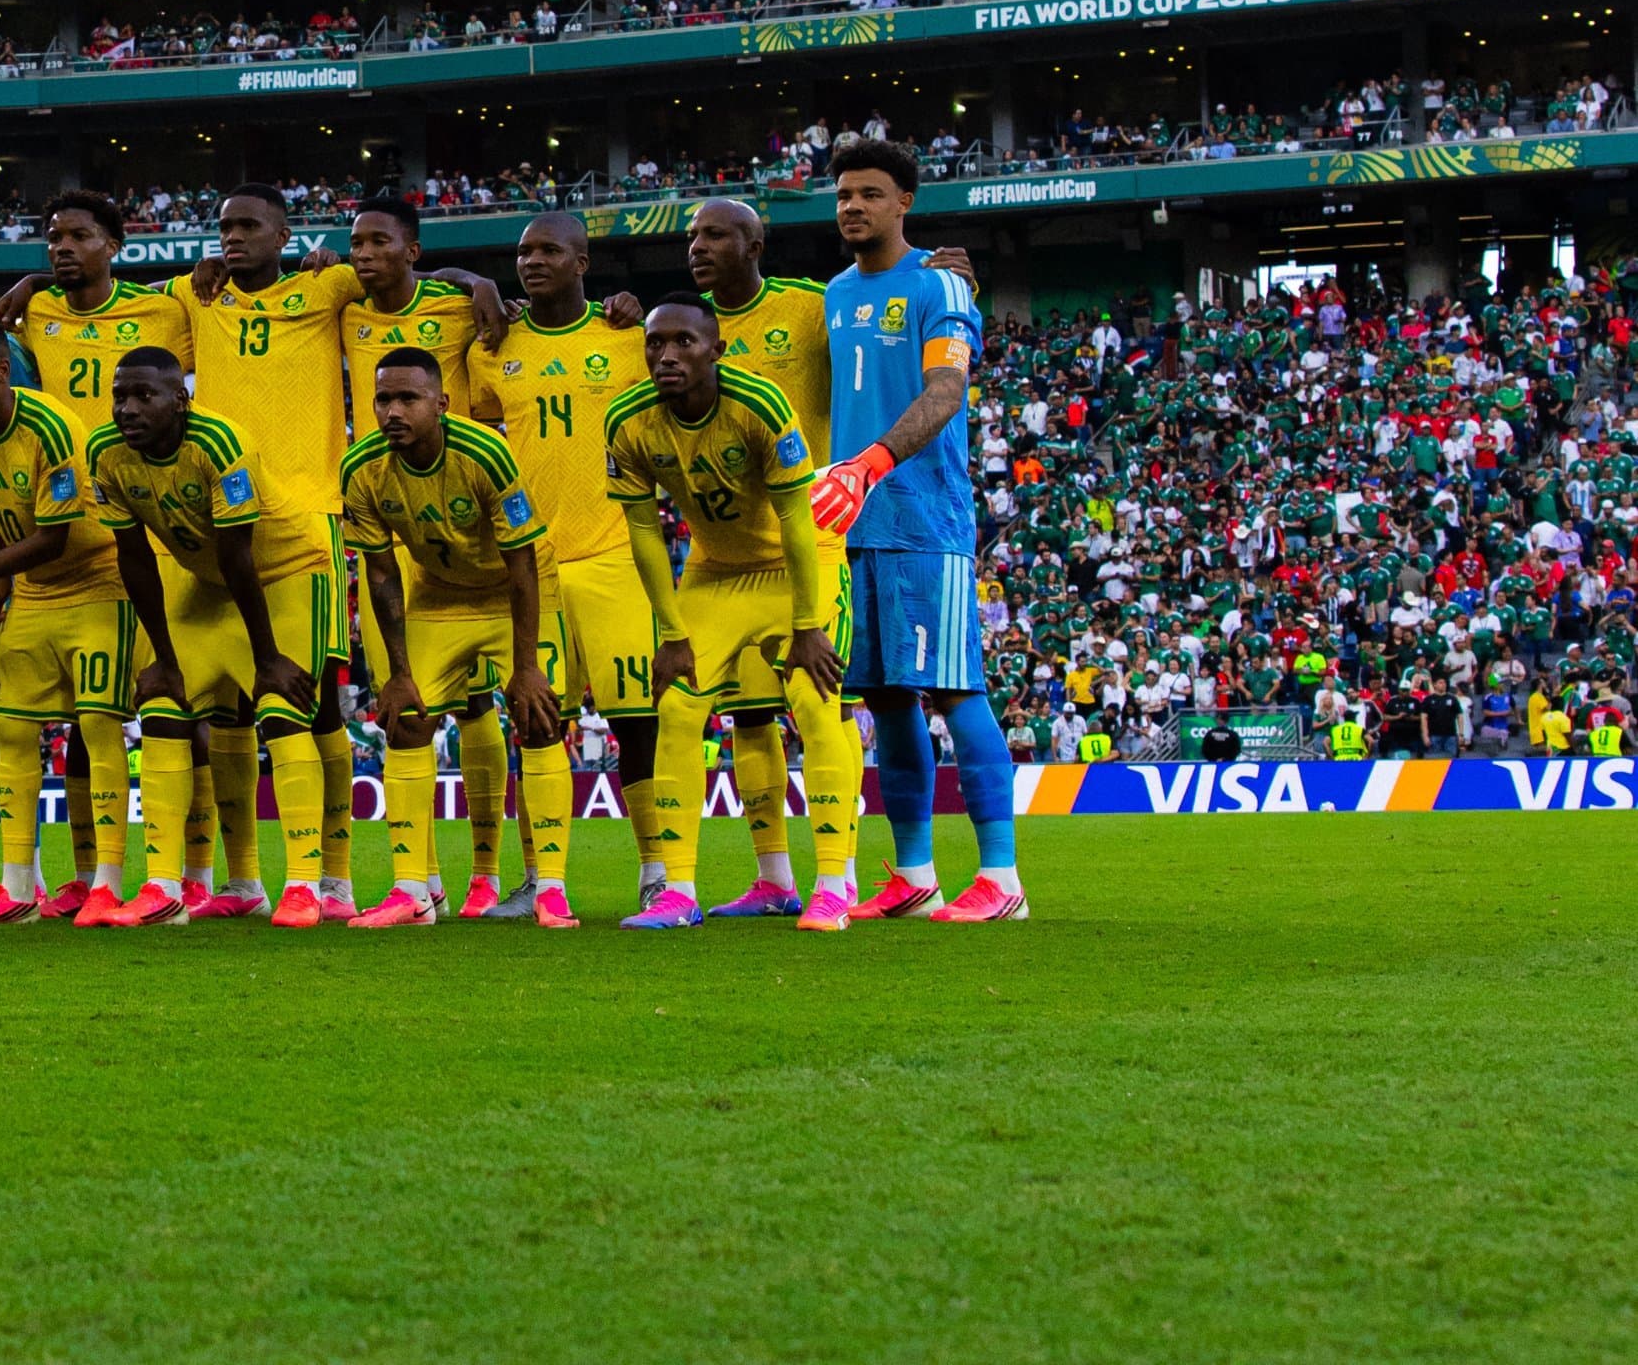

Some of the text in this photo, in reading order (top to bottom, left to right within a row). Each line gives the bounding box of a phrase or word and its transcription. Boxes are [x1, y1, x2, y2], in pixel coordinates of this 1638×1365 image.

[975, 5, 1033, 31] FIFA
[238, 67, 357, 92] #FIFAWorldCup
[967, 179, 1097, 206] #FIFAWorldCup
[111, 234, 327, 264] ONTEEY
[239, 317, 270, 357] 13
[69, 358, 101, 399] 21
[854, 345, 864, 392] 1
[536, 394, 573, 439] 14
[692, 487, 740, 523] 12
[171, 525, 200, 552] 6
[426, 538, 451, 569] 7
[915, 624, 927, 672] 1
[80, 651, 110, 695] 10
[614, 656, 650, 700] 14
[1126, 763, 1309, 813] VISA
[1492, 759, 1638, 810] VIS
[288, 829, 320, 839] SAFA
